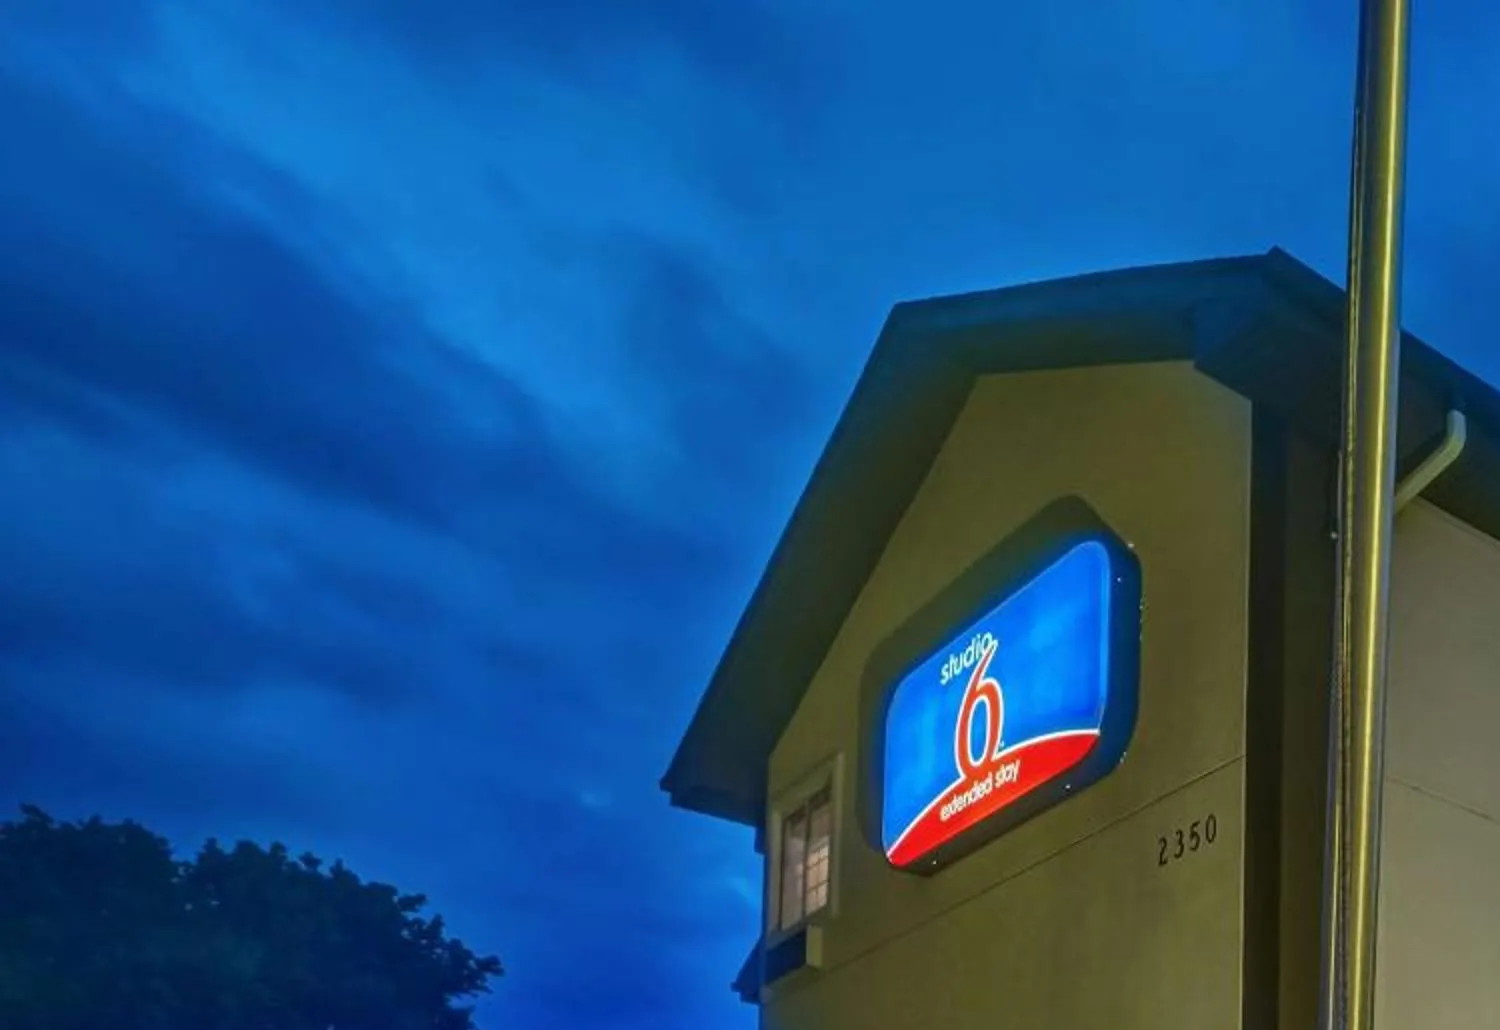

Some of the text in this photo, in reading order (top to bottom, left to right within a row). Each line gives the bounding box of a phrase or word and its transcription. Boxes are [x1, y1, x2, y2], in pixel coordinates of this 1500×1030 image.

[939, 631, 993, 686] studio
[954, 639, 1004, 779] 6
[939, 760, 1021, 822] extended stay
[1158, 813, 1217, 867] 2350
